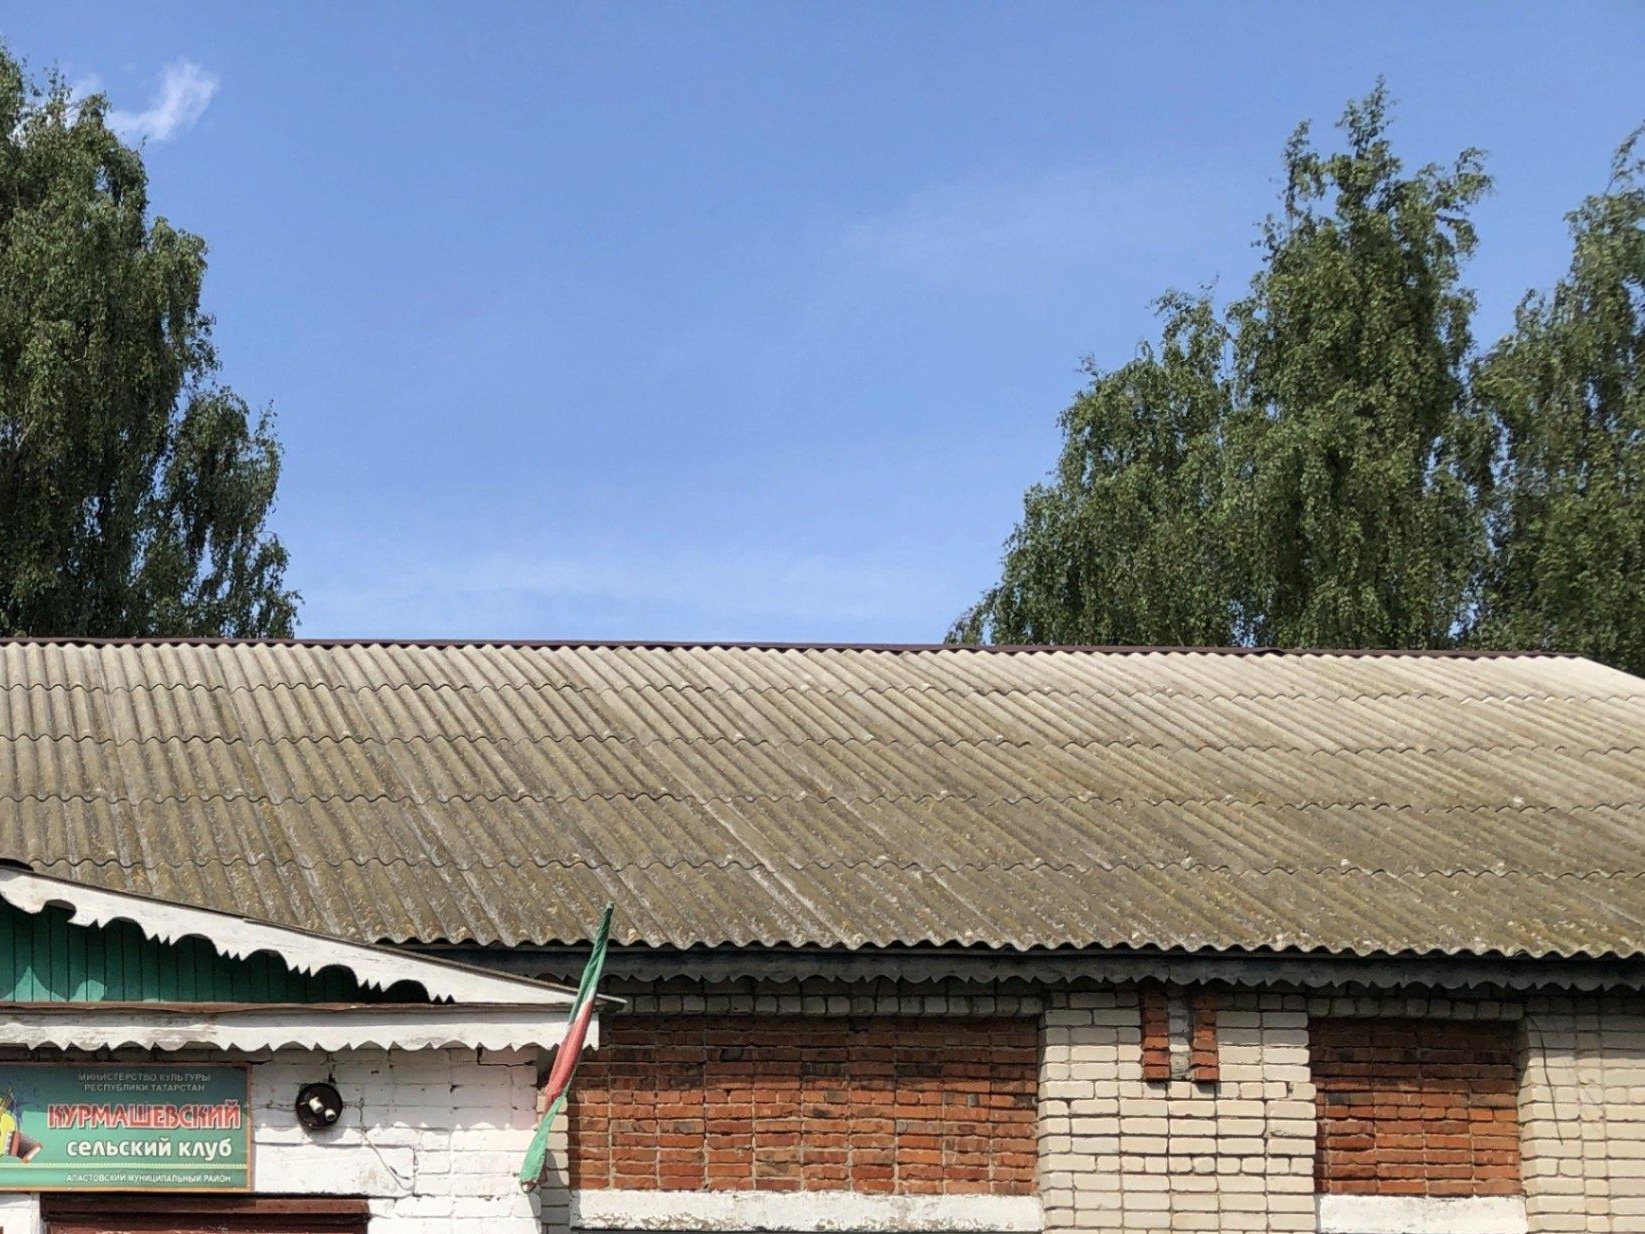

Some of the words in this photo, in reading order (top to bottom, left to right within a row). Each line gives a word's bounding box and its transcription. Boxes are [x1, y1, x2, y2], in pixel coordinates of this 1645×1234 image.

[78, 1072, 157, 1082] МИНИСТЕРСТВО
[160, 1073, 211, 1082] КУЛЬТУРЫ
[84, 1083, 149, 1092] РЕСПУБЛИКИ
[151, 1083, 205, 1092] ТАТАРСТАН
[47, 1099, 243, 1130] КУРМАШЕВСКИЙ
[67, 1137, 171, 1157] сельский
[179, 1138, 232, 1161] клуб
